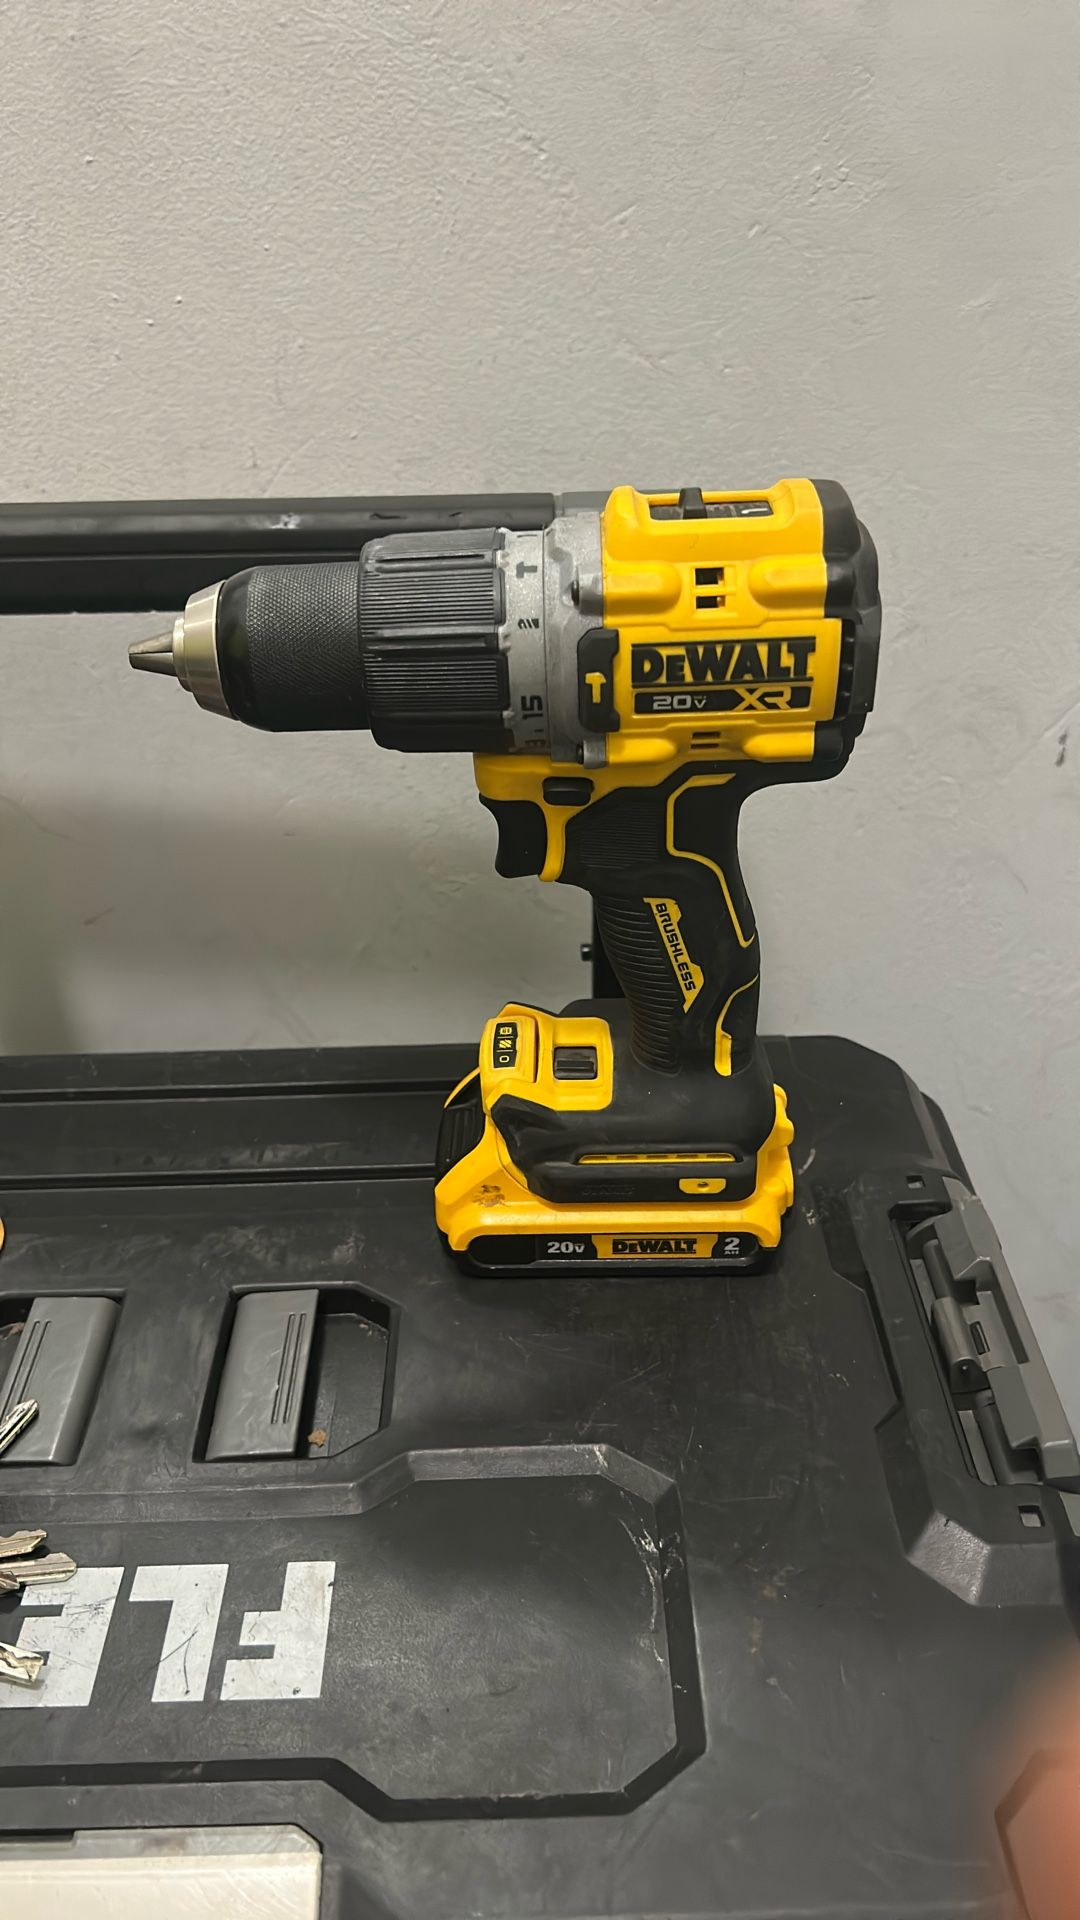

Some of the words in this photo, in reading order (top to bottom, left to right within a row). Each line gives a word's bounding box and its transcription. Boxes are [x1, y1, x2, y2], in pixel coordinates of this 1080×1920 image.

[631, 637, 816, 687] DEWALT
[521, 695, 543, 719] 15
[733, 686, 792, 711] XR
[655, 902, 696, 991] BRUSHLESS
[612, 1238, 697, 1254] DEWALT
[723, 1236, 741, 1250] 2
